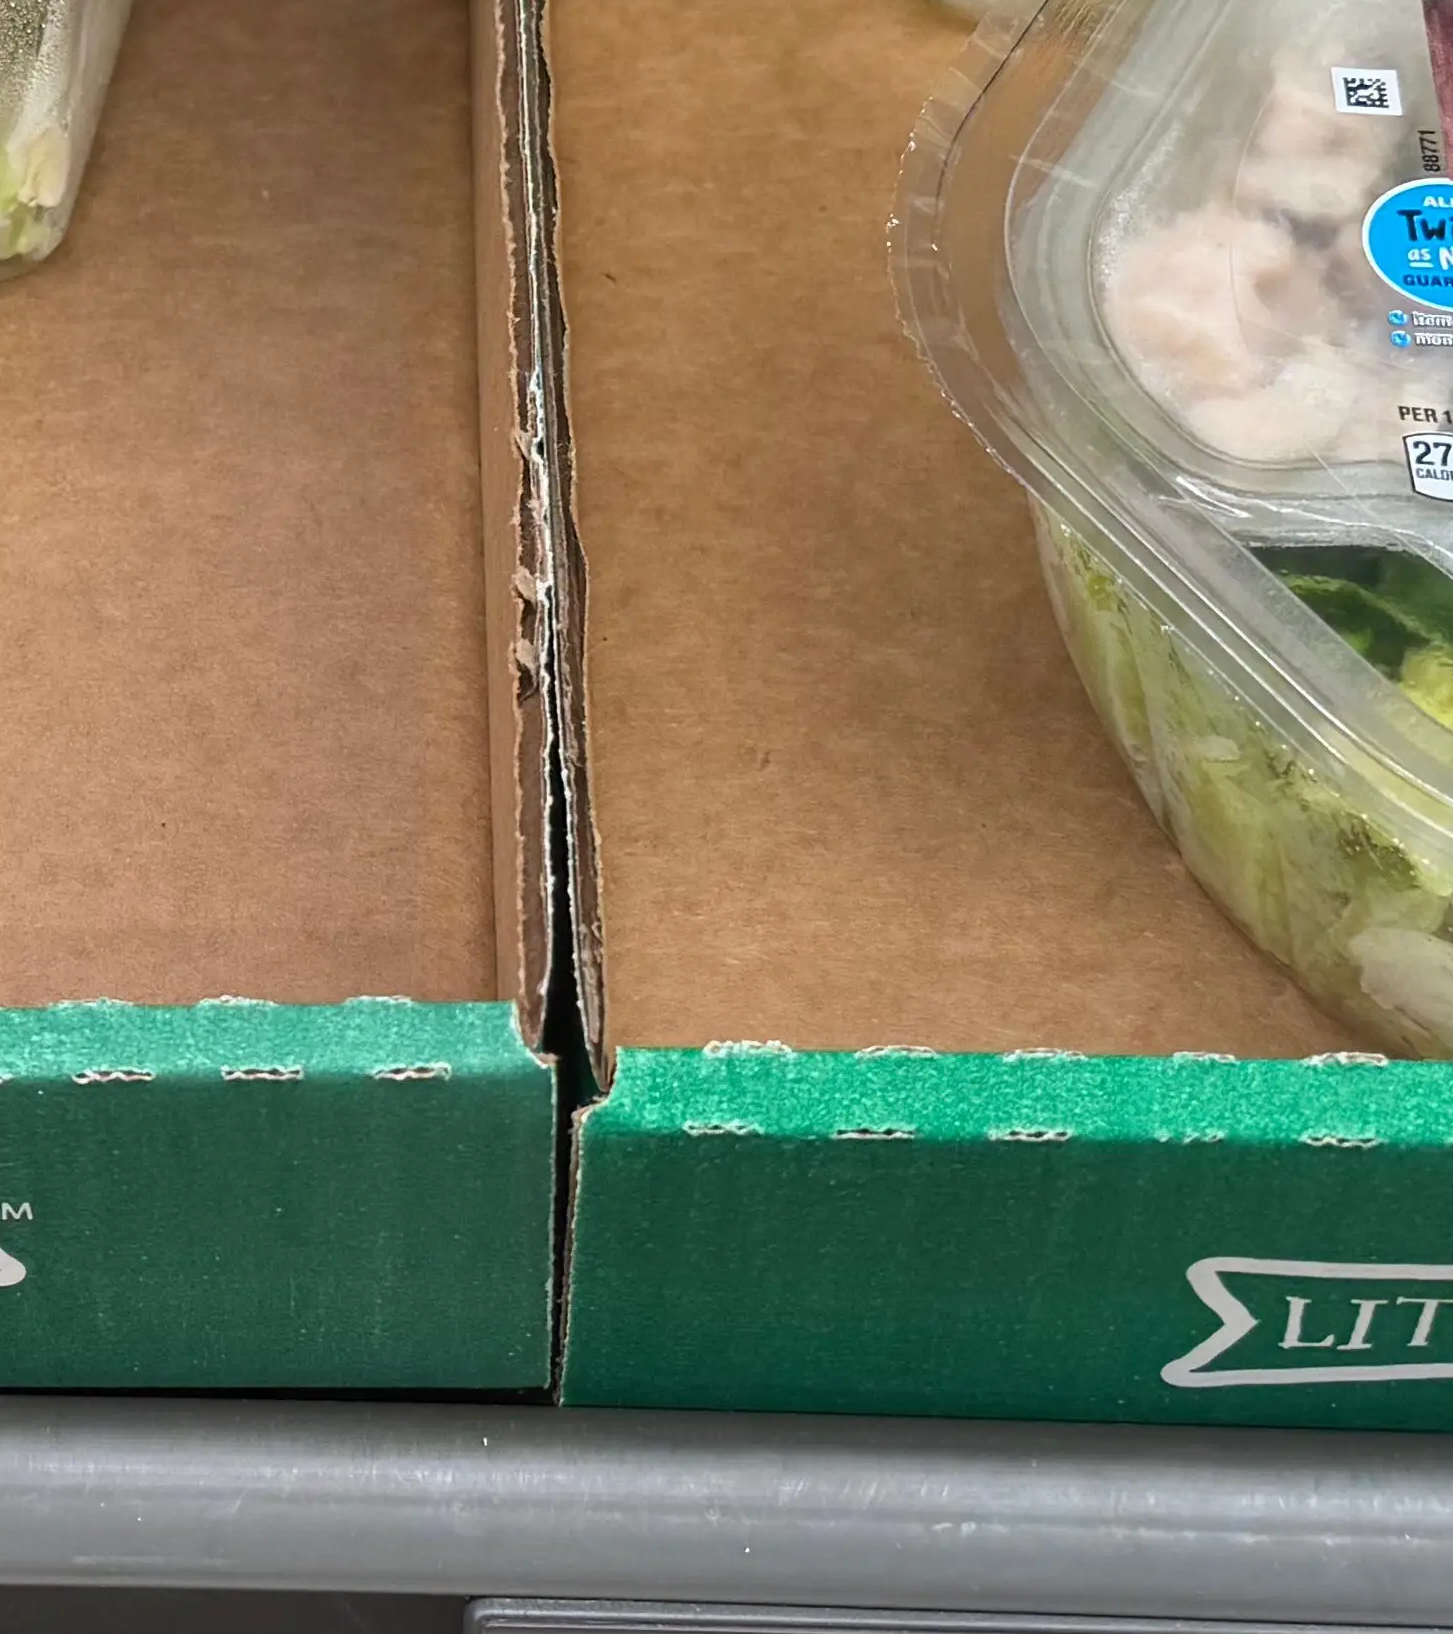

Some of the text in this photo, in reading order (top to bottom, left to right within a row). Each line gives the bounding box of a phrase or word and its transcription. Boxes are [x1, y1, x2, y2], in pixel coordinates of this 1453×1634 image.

[1417, 130, 1441, 172] 88771
[1407, 247, 1432, 262] as
[1398, 404, 1439, 425] PER
[1442, 409, 1453, 425] 1
